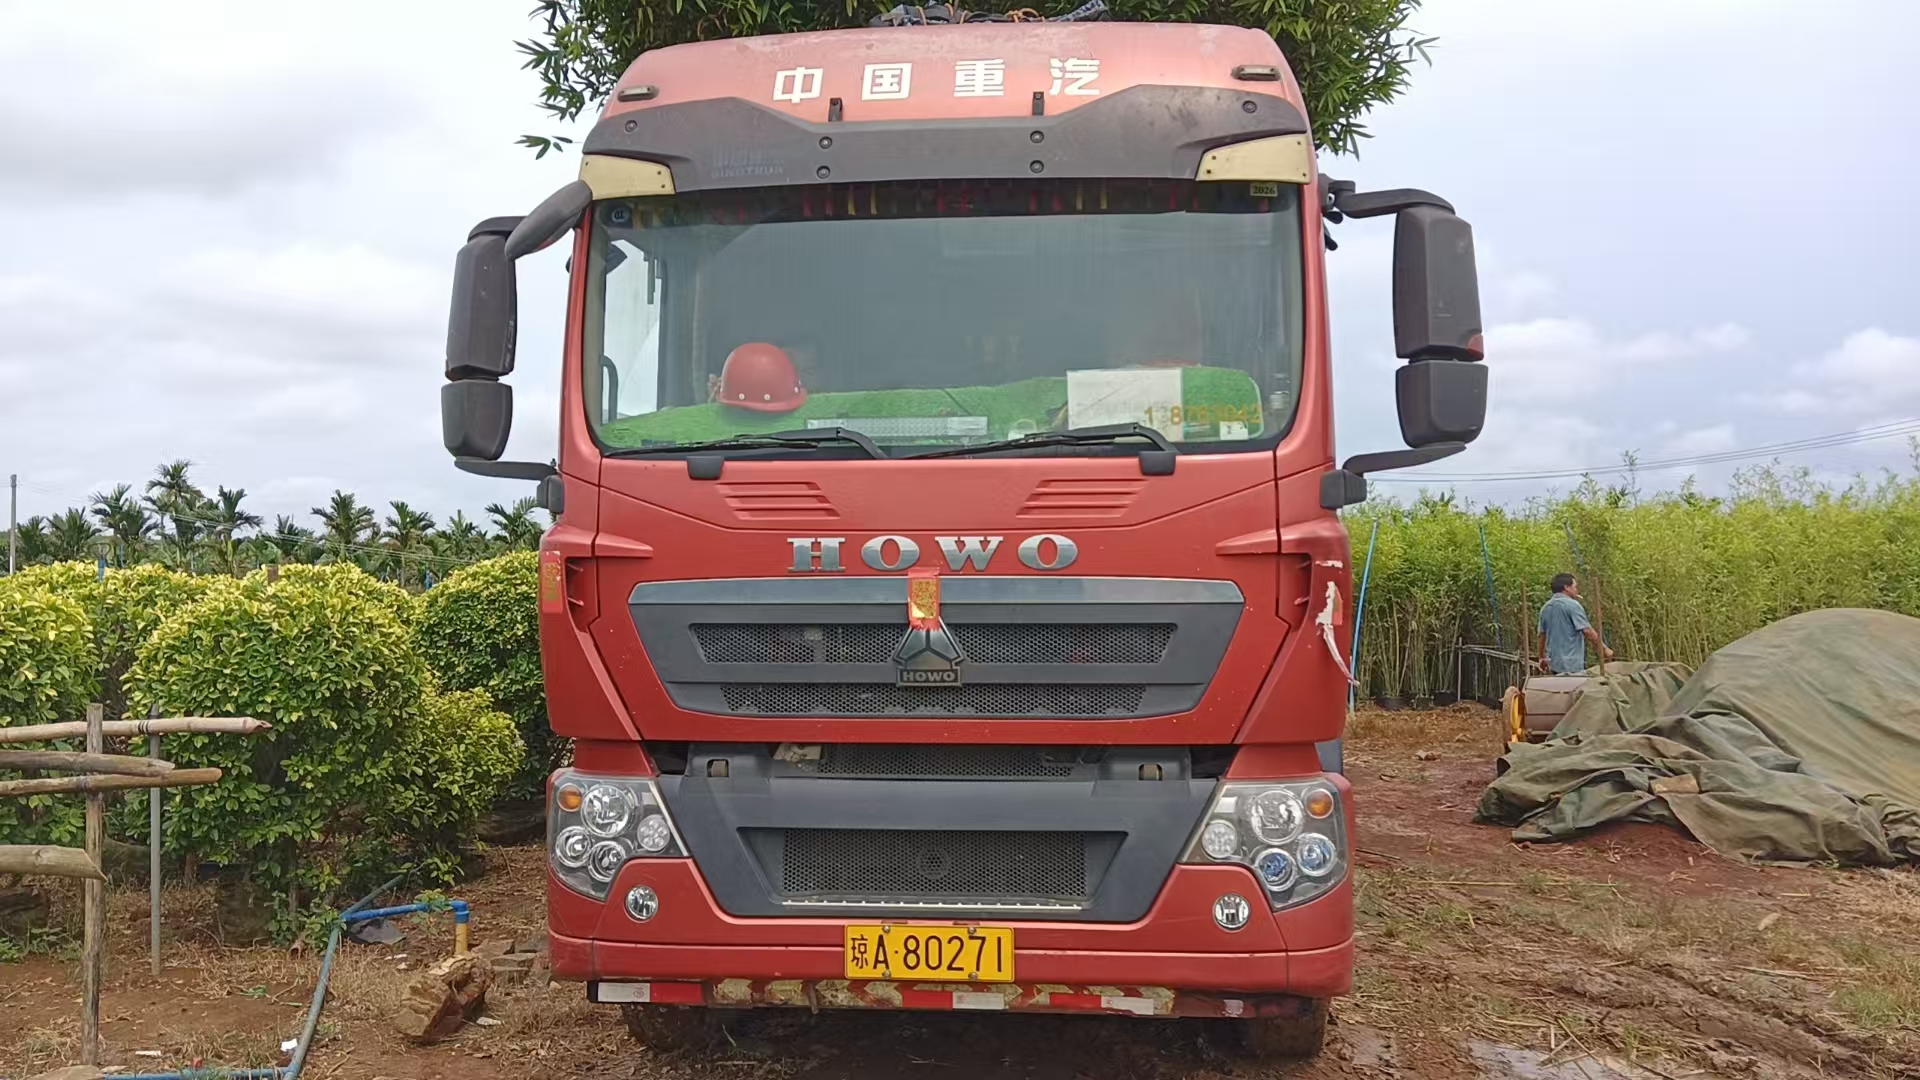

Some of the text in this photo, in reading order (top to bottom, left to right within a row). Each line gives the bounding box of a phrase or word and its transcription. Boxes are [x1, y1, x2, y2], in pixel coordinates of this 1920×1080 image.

[773, 57, 1101, 104] 中国重汽
[786, 533, 1079, 572] HOWO
[902, 670, 956, 682] HOWO
[851, 933, 1002, 973] 琼A·80271
